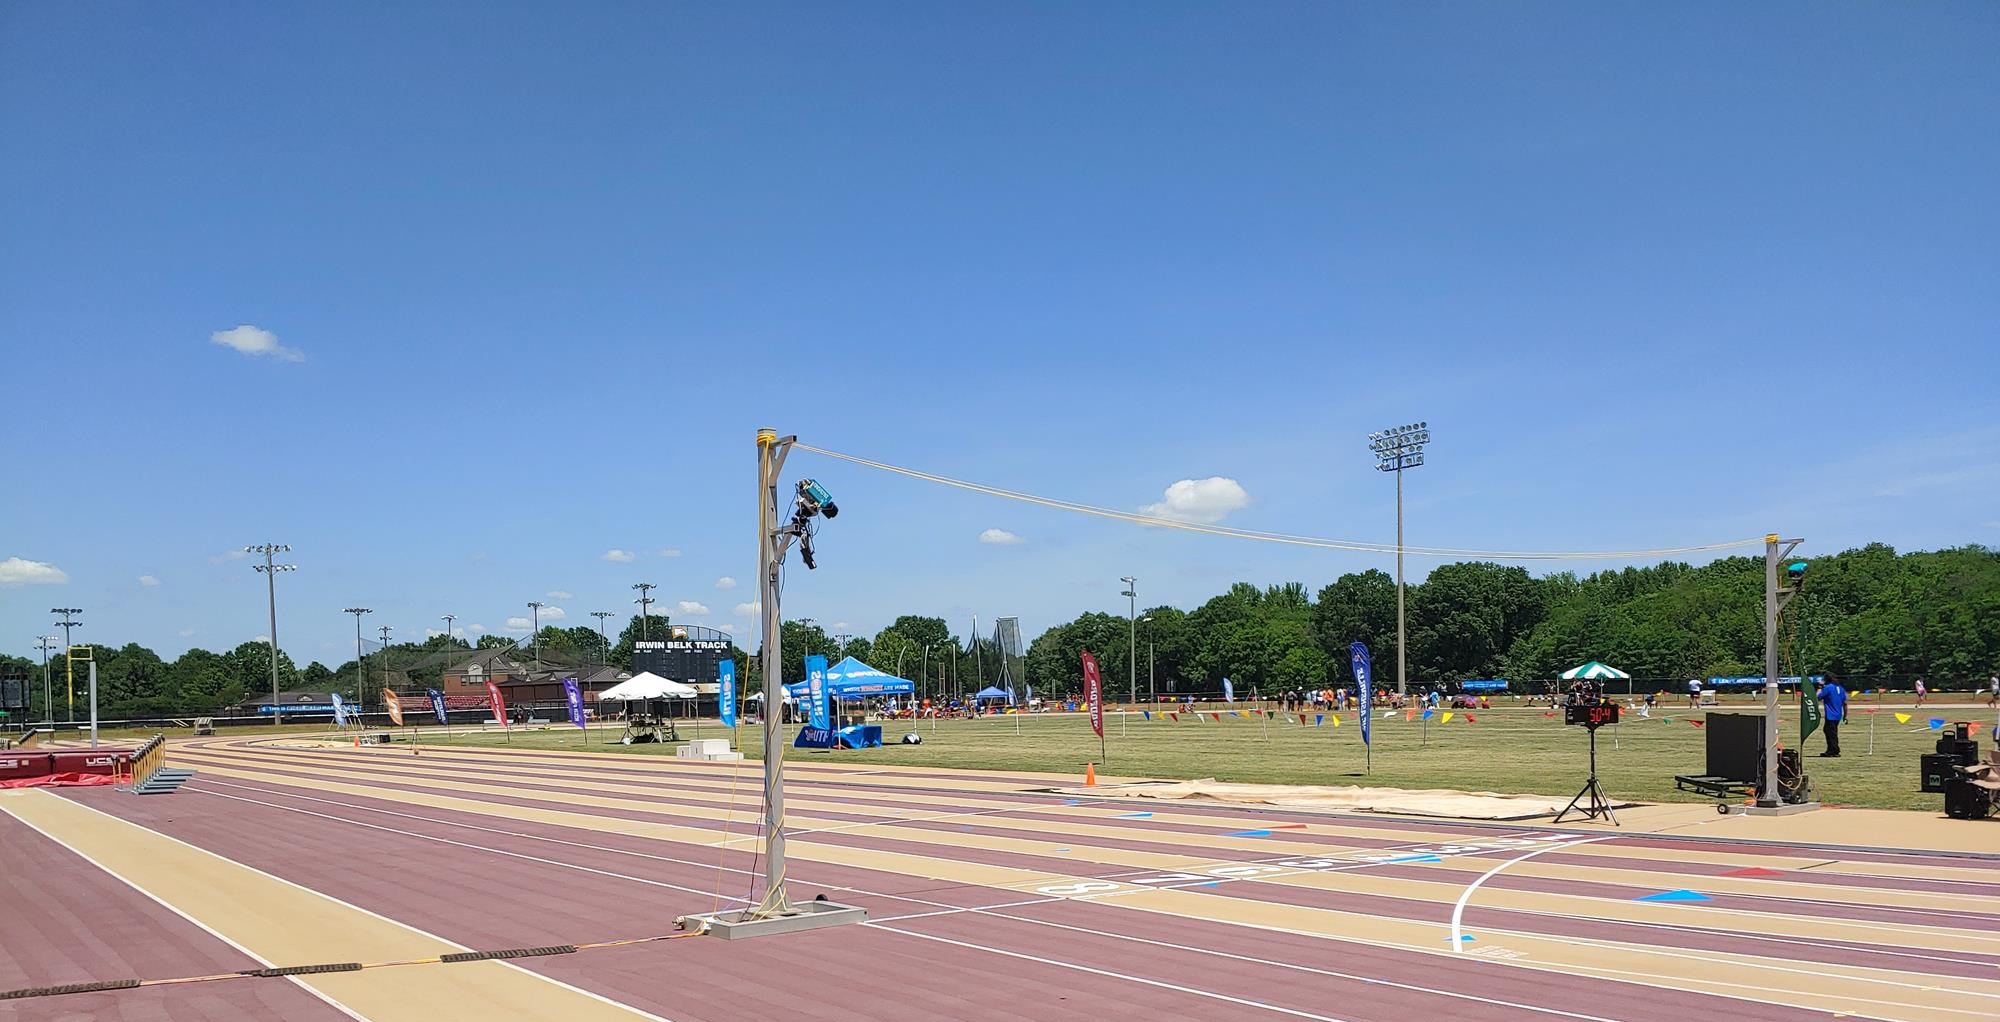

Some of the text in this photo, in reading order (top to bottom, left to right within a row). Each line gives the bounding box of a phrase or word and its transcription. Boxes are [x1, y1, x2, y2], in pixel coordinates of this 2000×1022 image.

[635, 641, 728, 649] IRWIN BELK TRACK
[1038, 882, 1120, 895] 8
